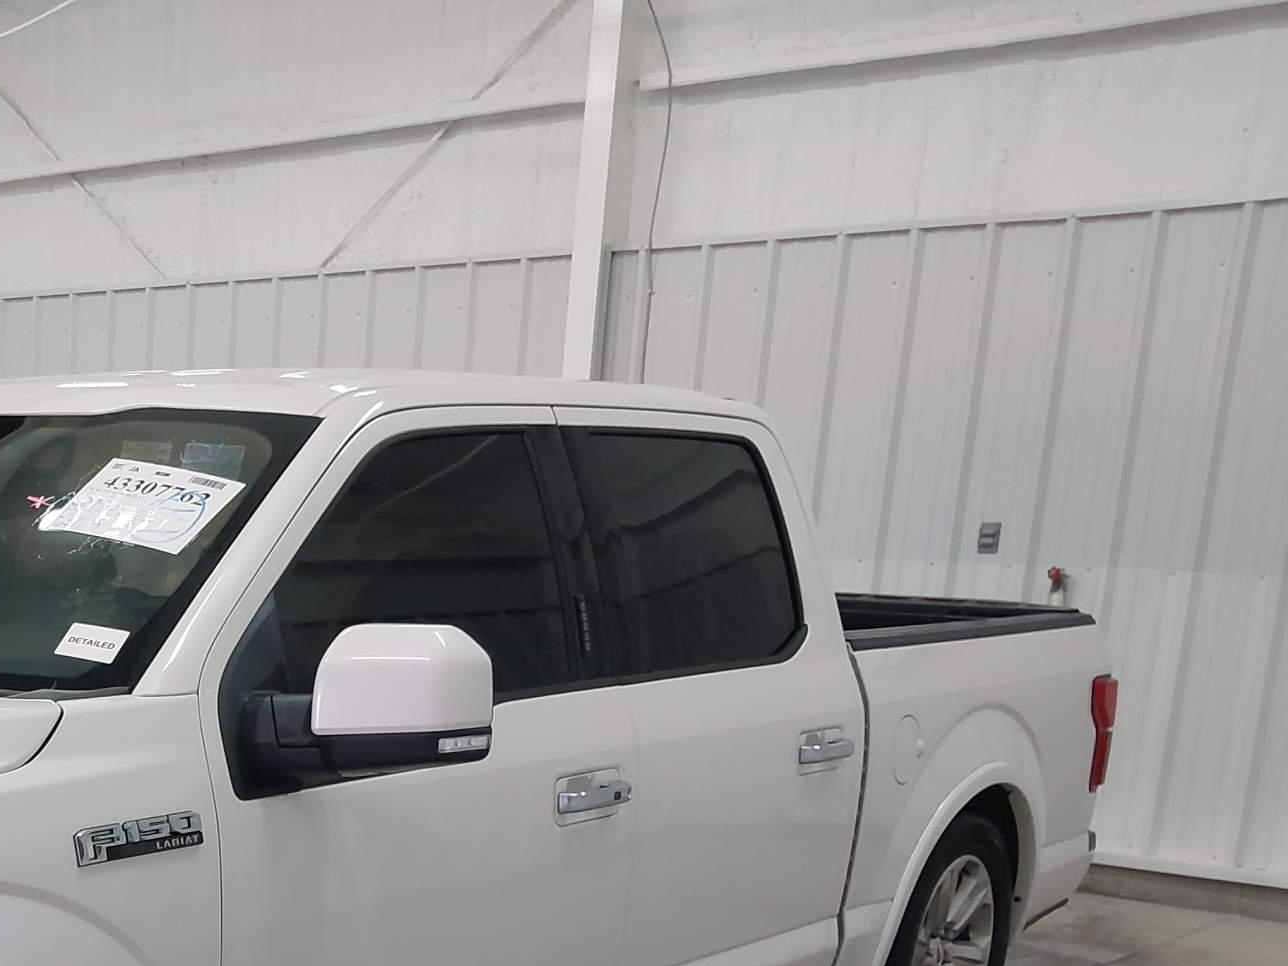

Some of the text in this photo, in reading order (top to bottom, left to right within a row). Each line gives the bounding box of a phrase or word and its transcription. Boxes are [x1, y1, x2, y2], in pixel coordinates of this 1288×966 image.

[104, 476, 210, 505] 43307762
[67, 636, 116, 650] DETAILED
[156, 834, 199, 850] LARIAT
